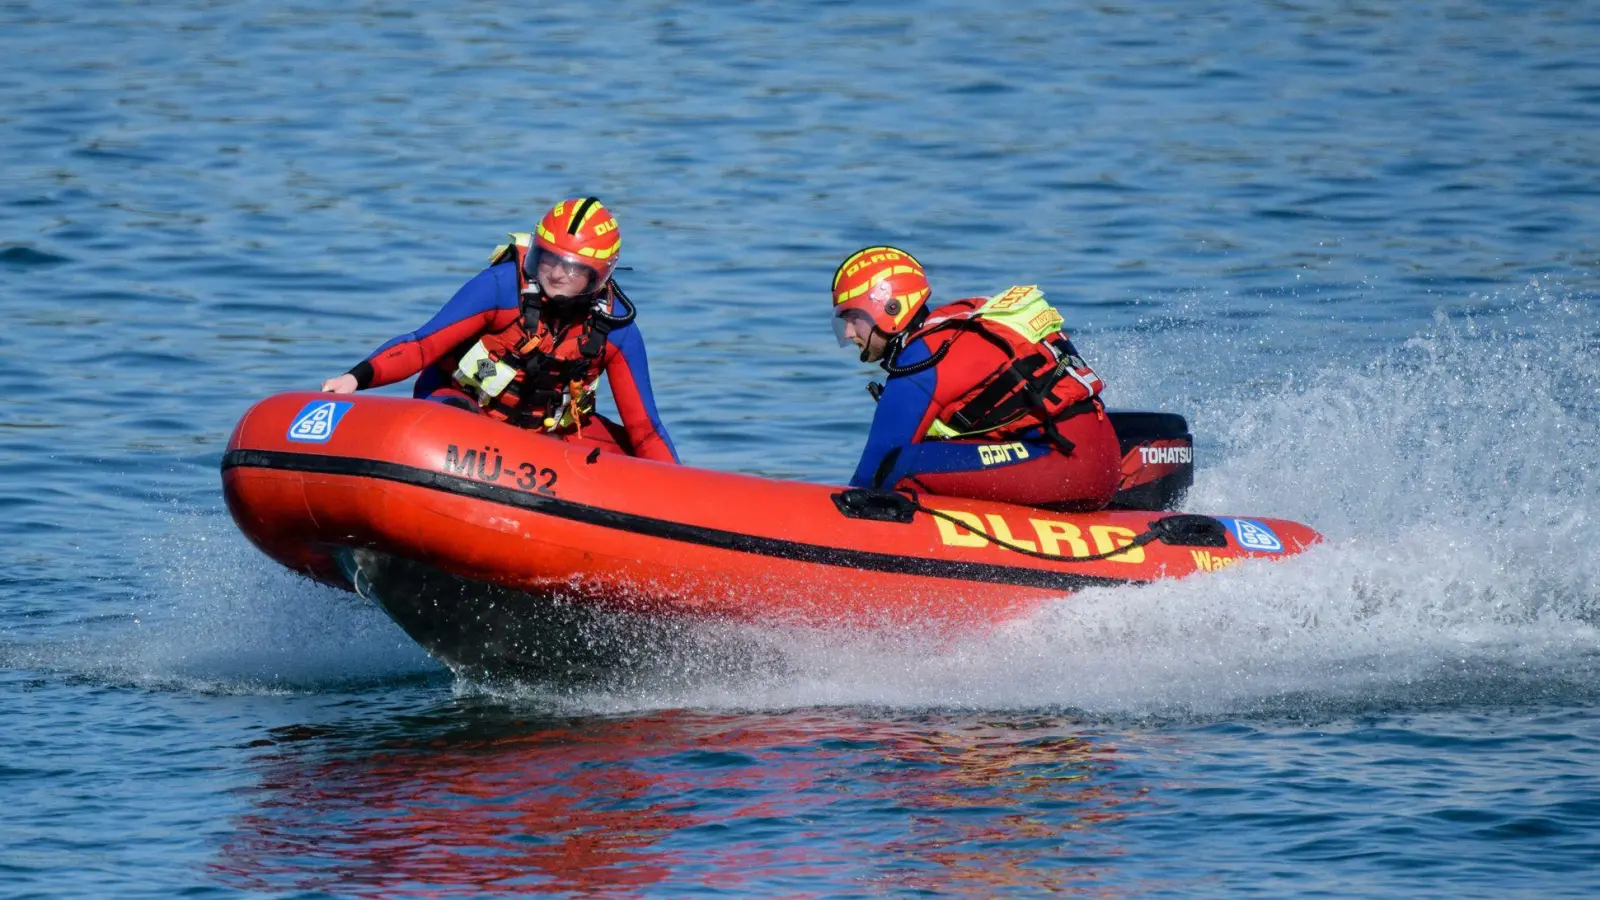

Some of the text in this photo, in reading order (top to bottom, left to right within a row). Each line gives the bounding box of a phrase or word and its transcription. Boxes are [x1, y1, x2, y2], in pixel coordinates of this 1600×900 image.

[846, 253, 900, 278] DLRG
[443, 444, 558, 496] MÜ-32
[1139, 447, 1192, 464] TOHATSU
[933, 510, 1145, 564] DLRG
